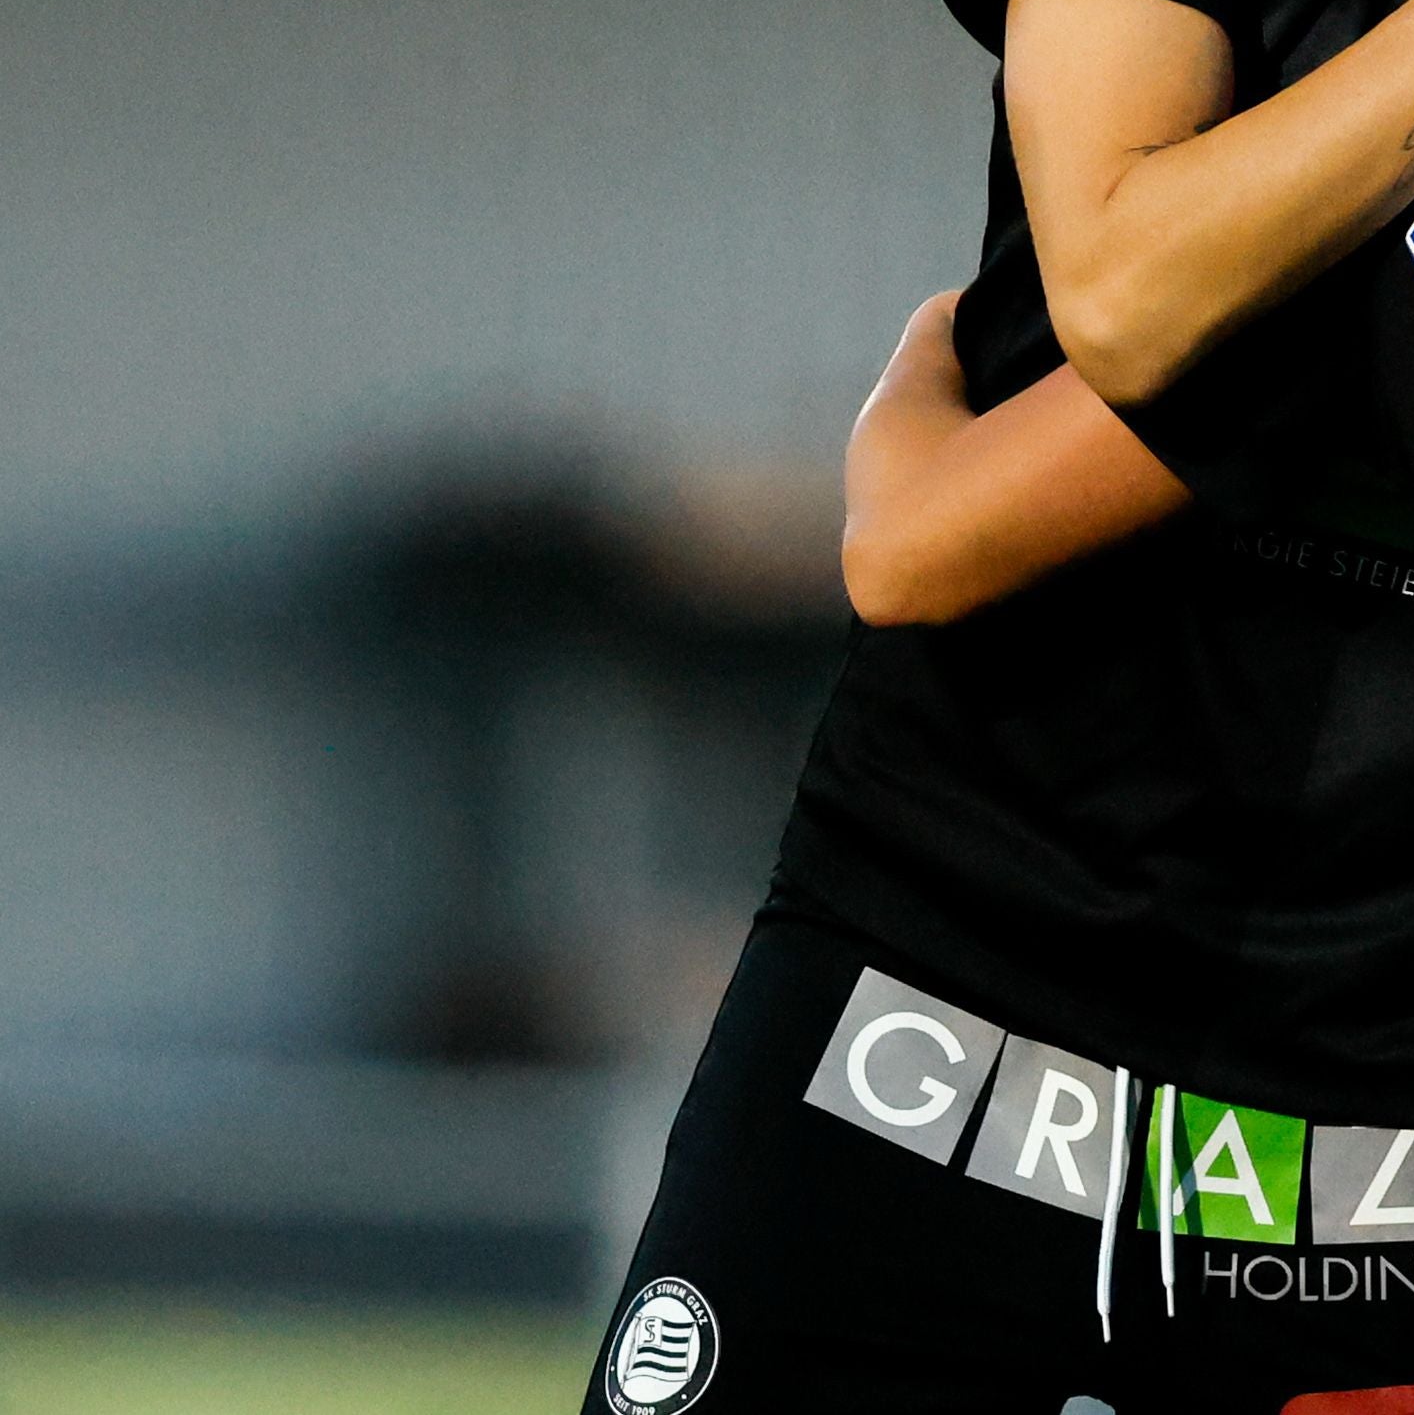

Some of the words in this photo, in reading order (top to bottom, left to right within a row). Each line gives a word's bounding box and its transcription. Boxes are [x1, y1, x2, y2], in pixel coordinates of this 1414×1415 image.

[643, 1288, 655, 1302] SK
[656, 1283, 686, 1299] STURM
[686, 1295, 709, 1326] GRAZ
[612, 1392, 631, 1413] SEIT
